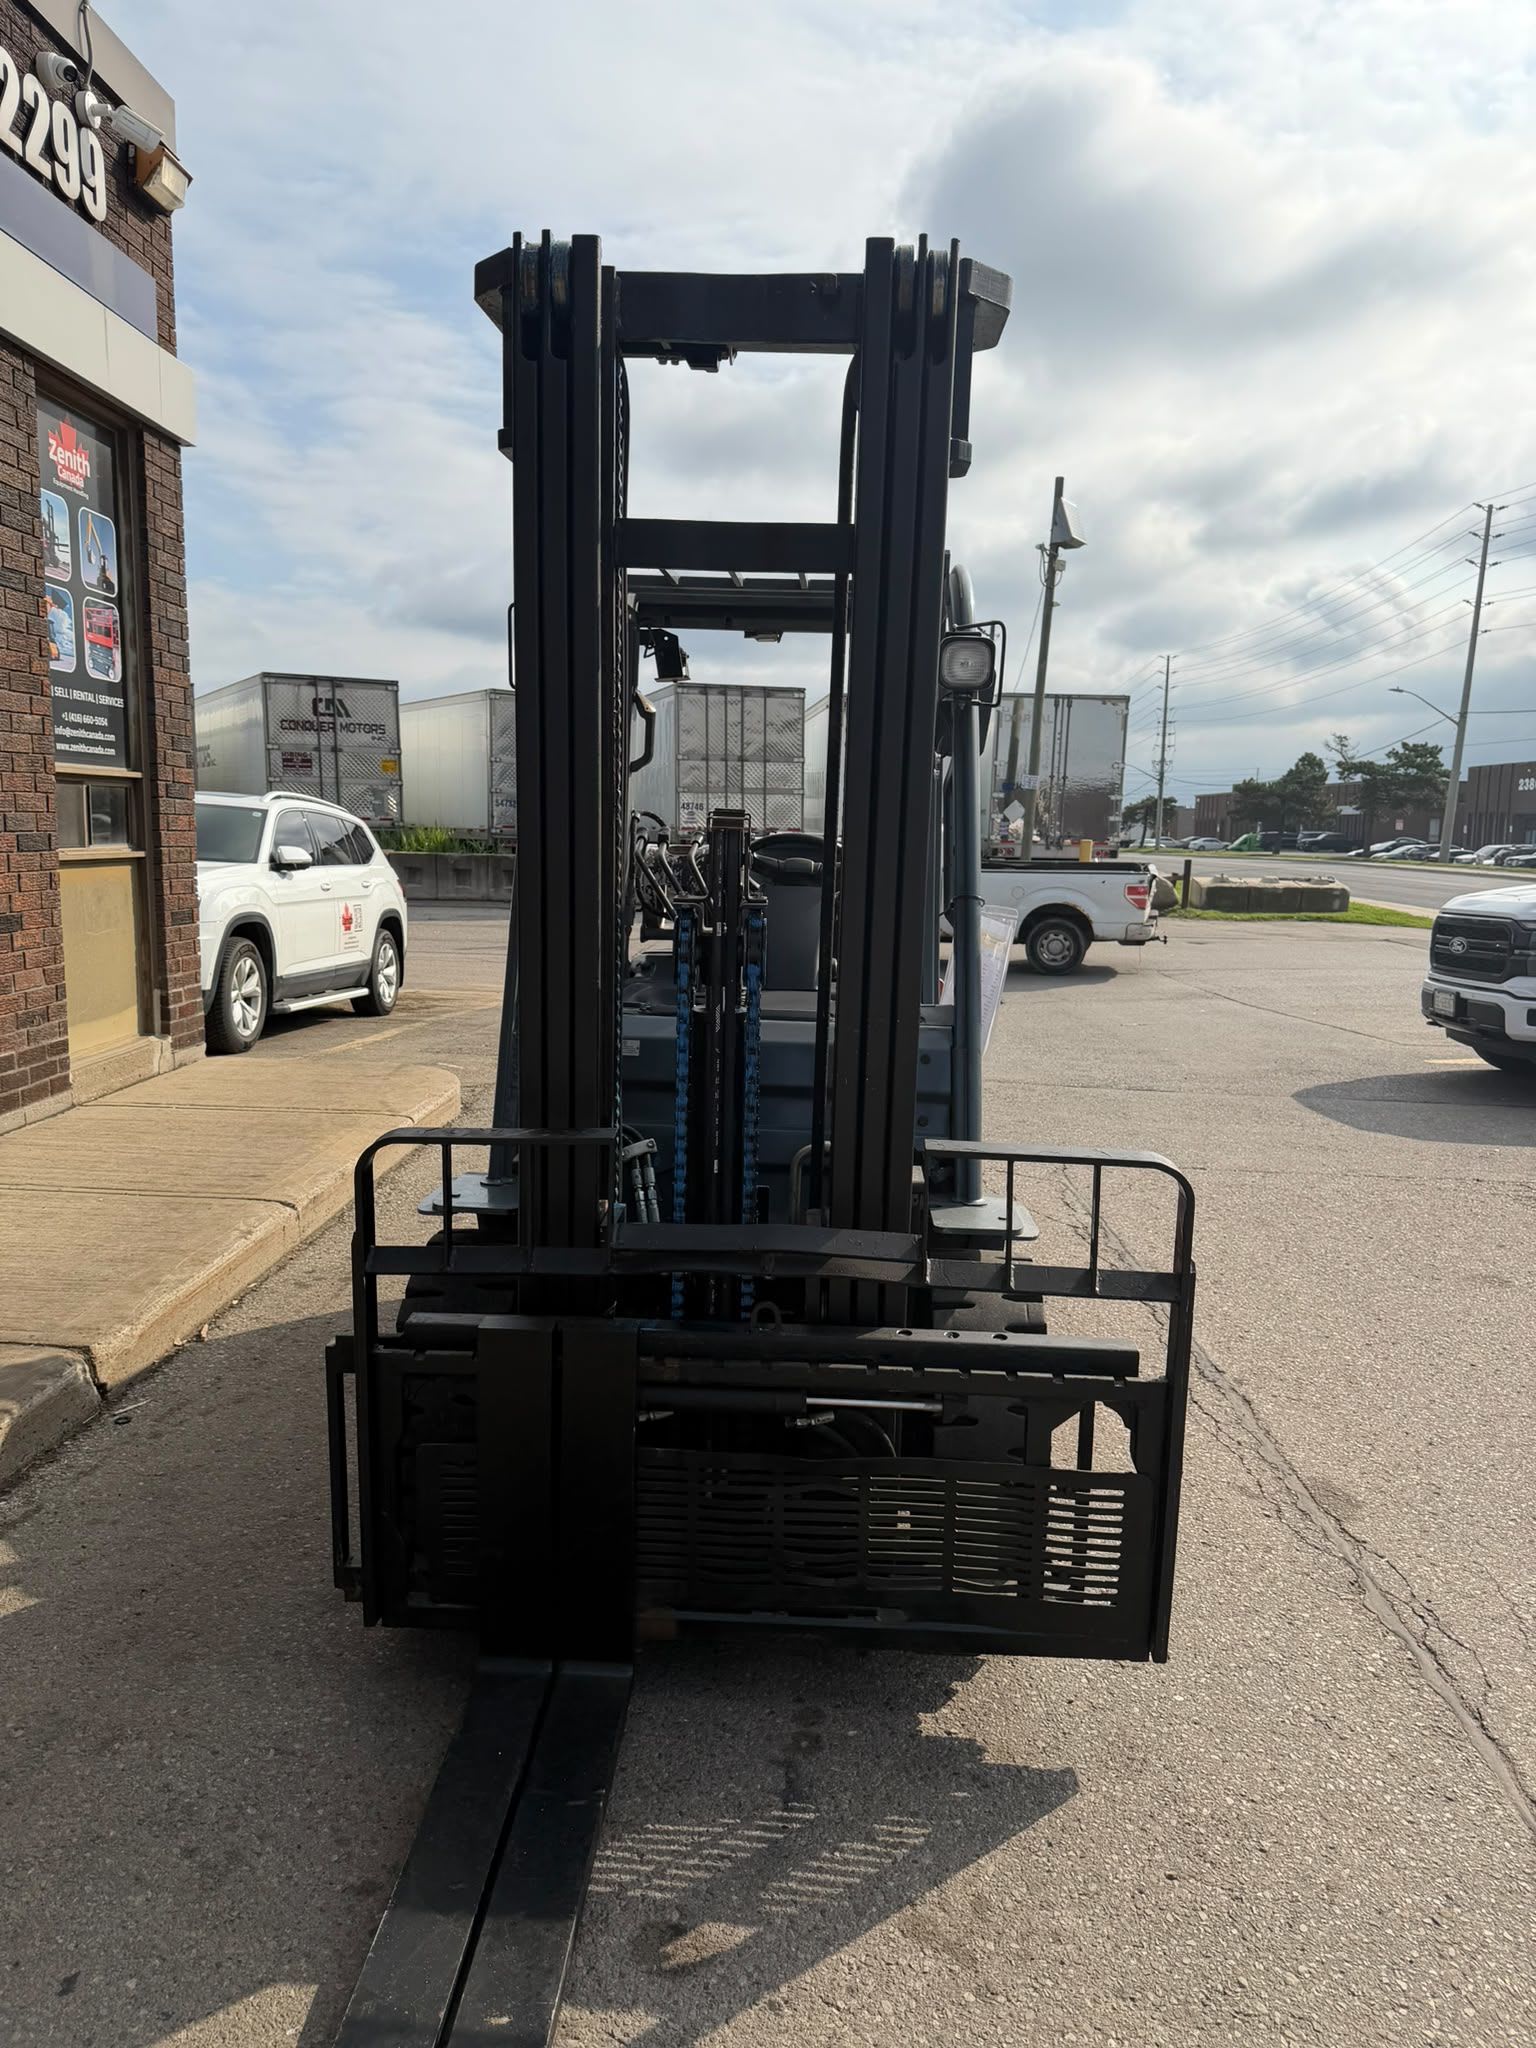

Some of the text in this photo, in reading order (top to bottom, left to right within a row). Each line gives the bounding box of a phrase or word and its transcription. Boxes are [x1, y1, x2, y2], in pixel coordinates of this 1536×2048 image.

[0, 46, 107, 222] 2299
[49, 437, 91, 477] Zenith
[57, 464, 85, 488] Canada
[54, 686, 124, 708] SELL RENTAL SERVICES
[280, 719, 386, 735] CONQUER MOTORS
[1518, 777, 1536, 791] 238
